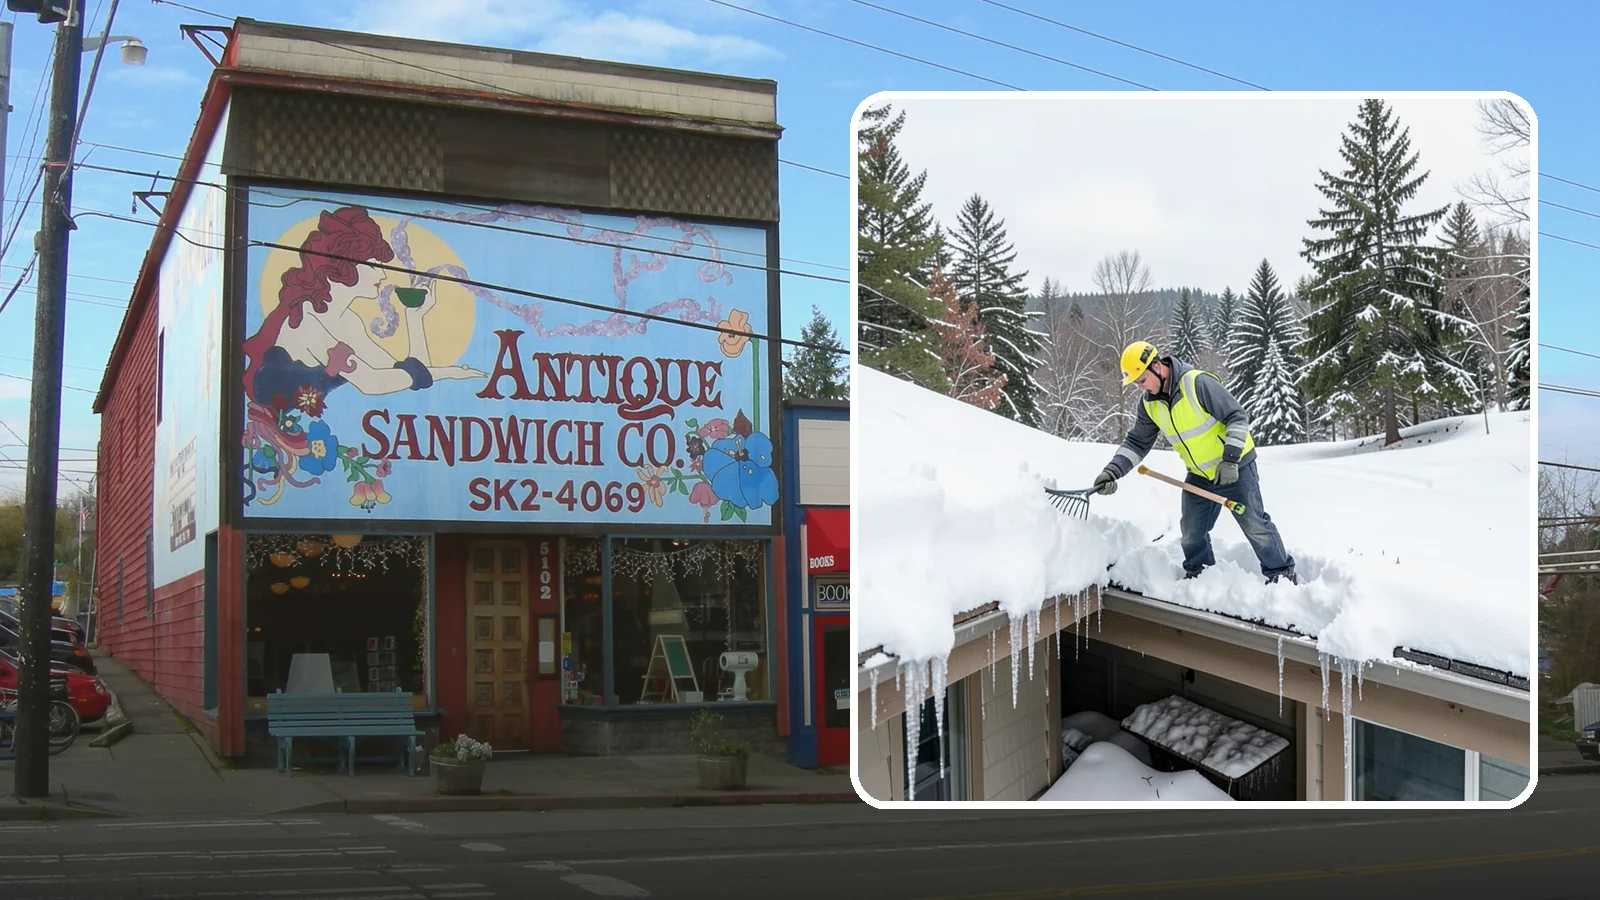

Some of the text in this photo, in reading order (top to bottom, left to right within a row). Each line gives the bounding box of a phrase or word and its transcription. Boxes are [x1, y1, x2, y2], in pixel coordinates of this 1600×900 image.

[475, 329, 723, 421] ANTIQUE
[361, 408, 685, 469] SANDWICH CO.
[468, 477, 645, 512] SK2-4069
[539, 542, 552, 600] 5102
[809, 555, 835, 569] BOOKS
